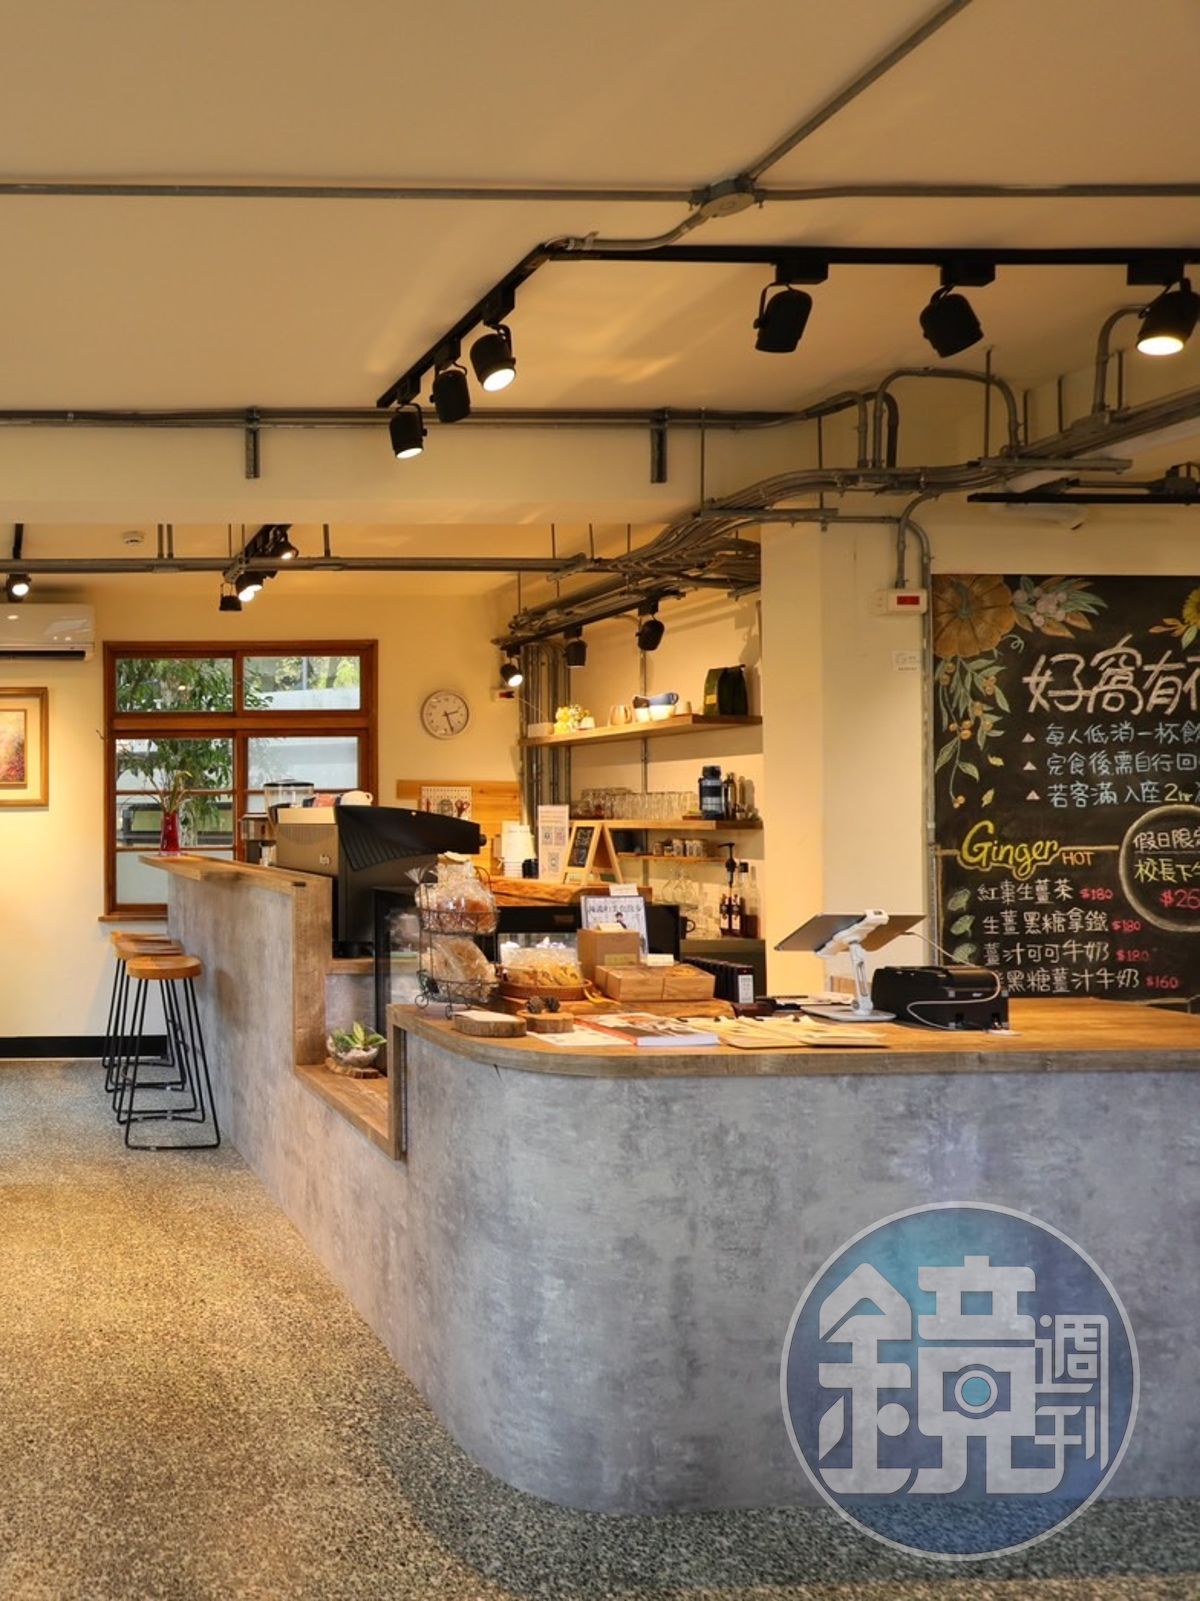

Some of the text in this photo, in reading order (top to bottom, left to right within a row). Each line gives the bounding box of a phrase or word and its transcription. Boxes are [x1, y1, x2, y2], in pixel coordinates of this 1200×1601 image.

[1047, 750, 1200, 776] 完食後需自行回
[1048, 780, 1200, 807] 若客滿入座2hr
[962, 820, 1095, 876] Ginger HOT
[984, 939, 1109, 966] 薑汁可可牛奶
[999, 967, 1140, 993] 黑糖薑汁牛奶
